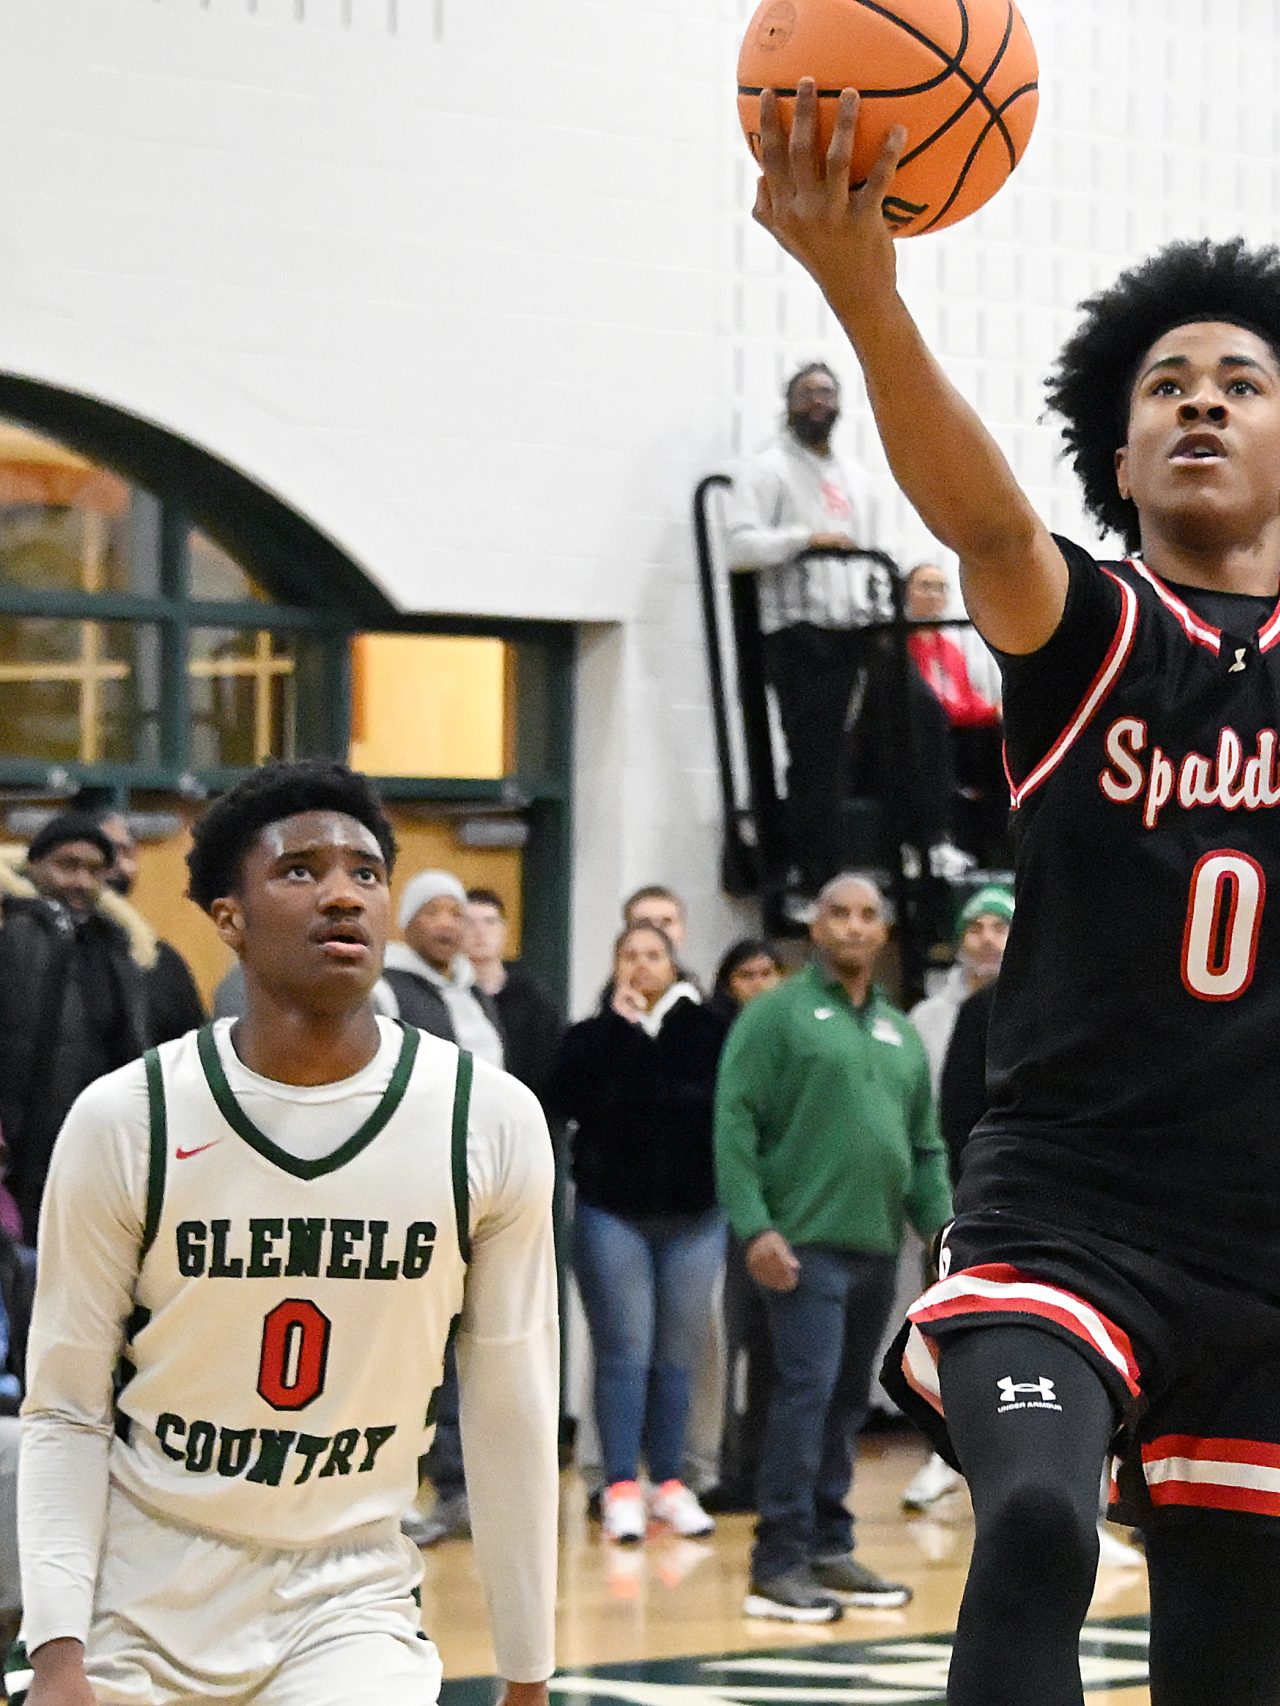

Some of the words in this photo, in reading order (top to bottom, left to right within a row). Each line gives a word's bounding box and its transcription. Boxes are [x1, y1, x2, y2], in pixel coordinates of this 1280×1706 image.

[1180, 848, 1266, 1001] 0
[176, 1218, 437, 1280] GLENELG
[257, 1298, 332, 1411] 0
[997, 1401, 1026, 1414] UNDER
[1026, 1401, 1063, 1412] ARMOUR
[155, 1412, 397, 1487] COUNTRY
